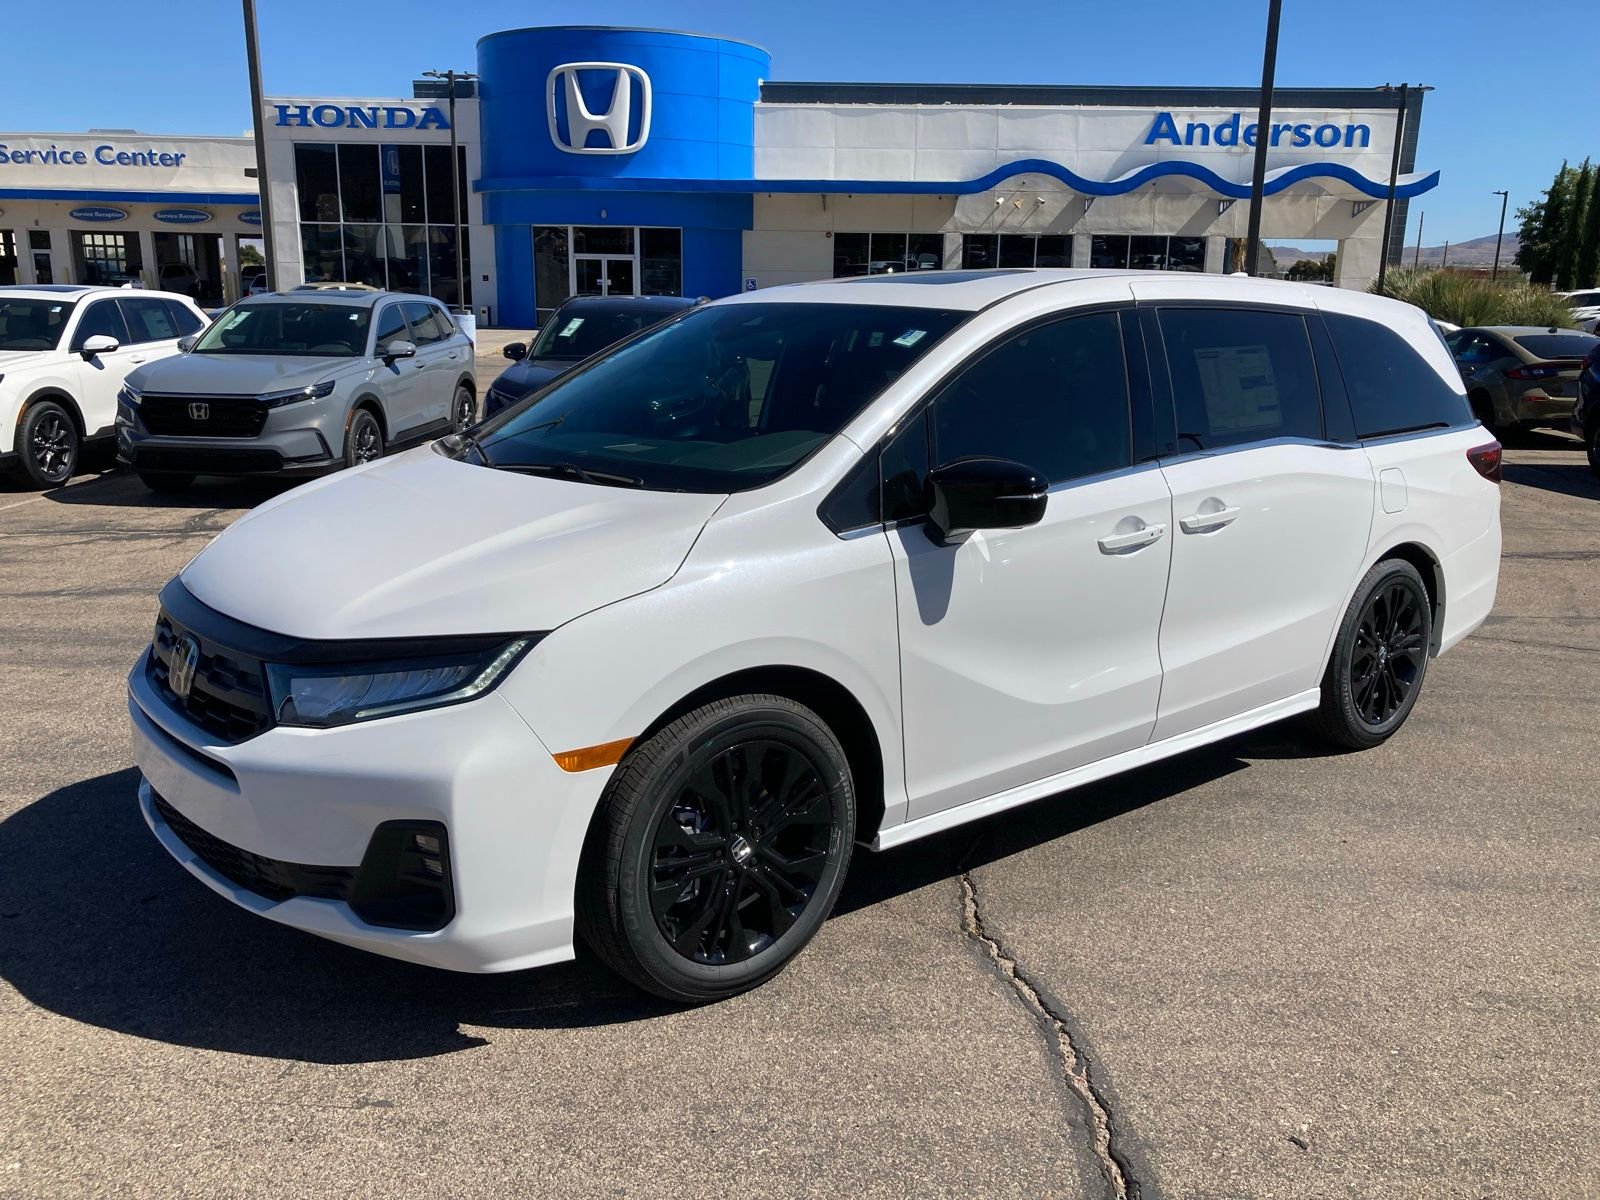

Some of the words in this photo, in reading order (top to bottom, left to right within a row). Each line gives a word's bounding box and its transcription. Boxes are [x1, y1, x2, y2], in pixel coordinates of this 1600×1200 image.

[273, 104, 451, 130] HONDA
[1144, 111, 1371, 148] Anderson
[0, 144, 87, 166] Service
[95, 145, 186, 168] Center
[94, 211, 123, 219] Reception
[178, 213, 208, 221] Reception
